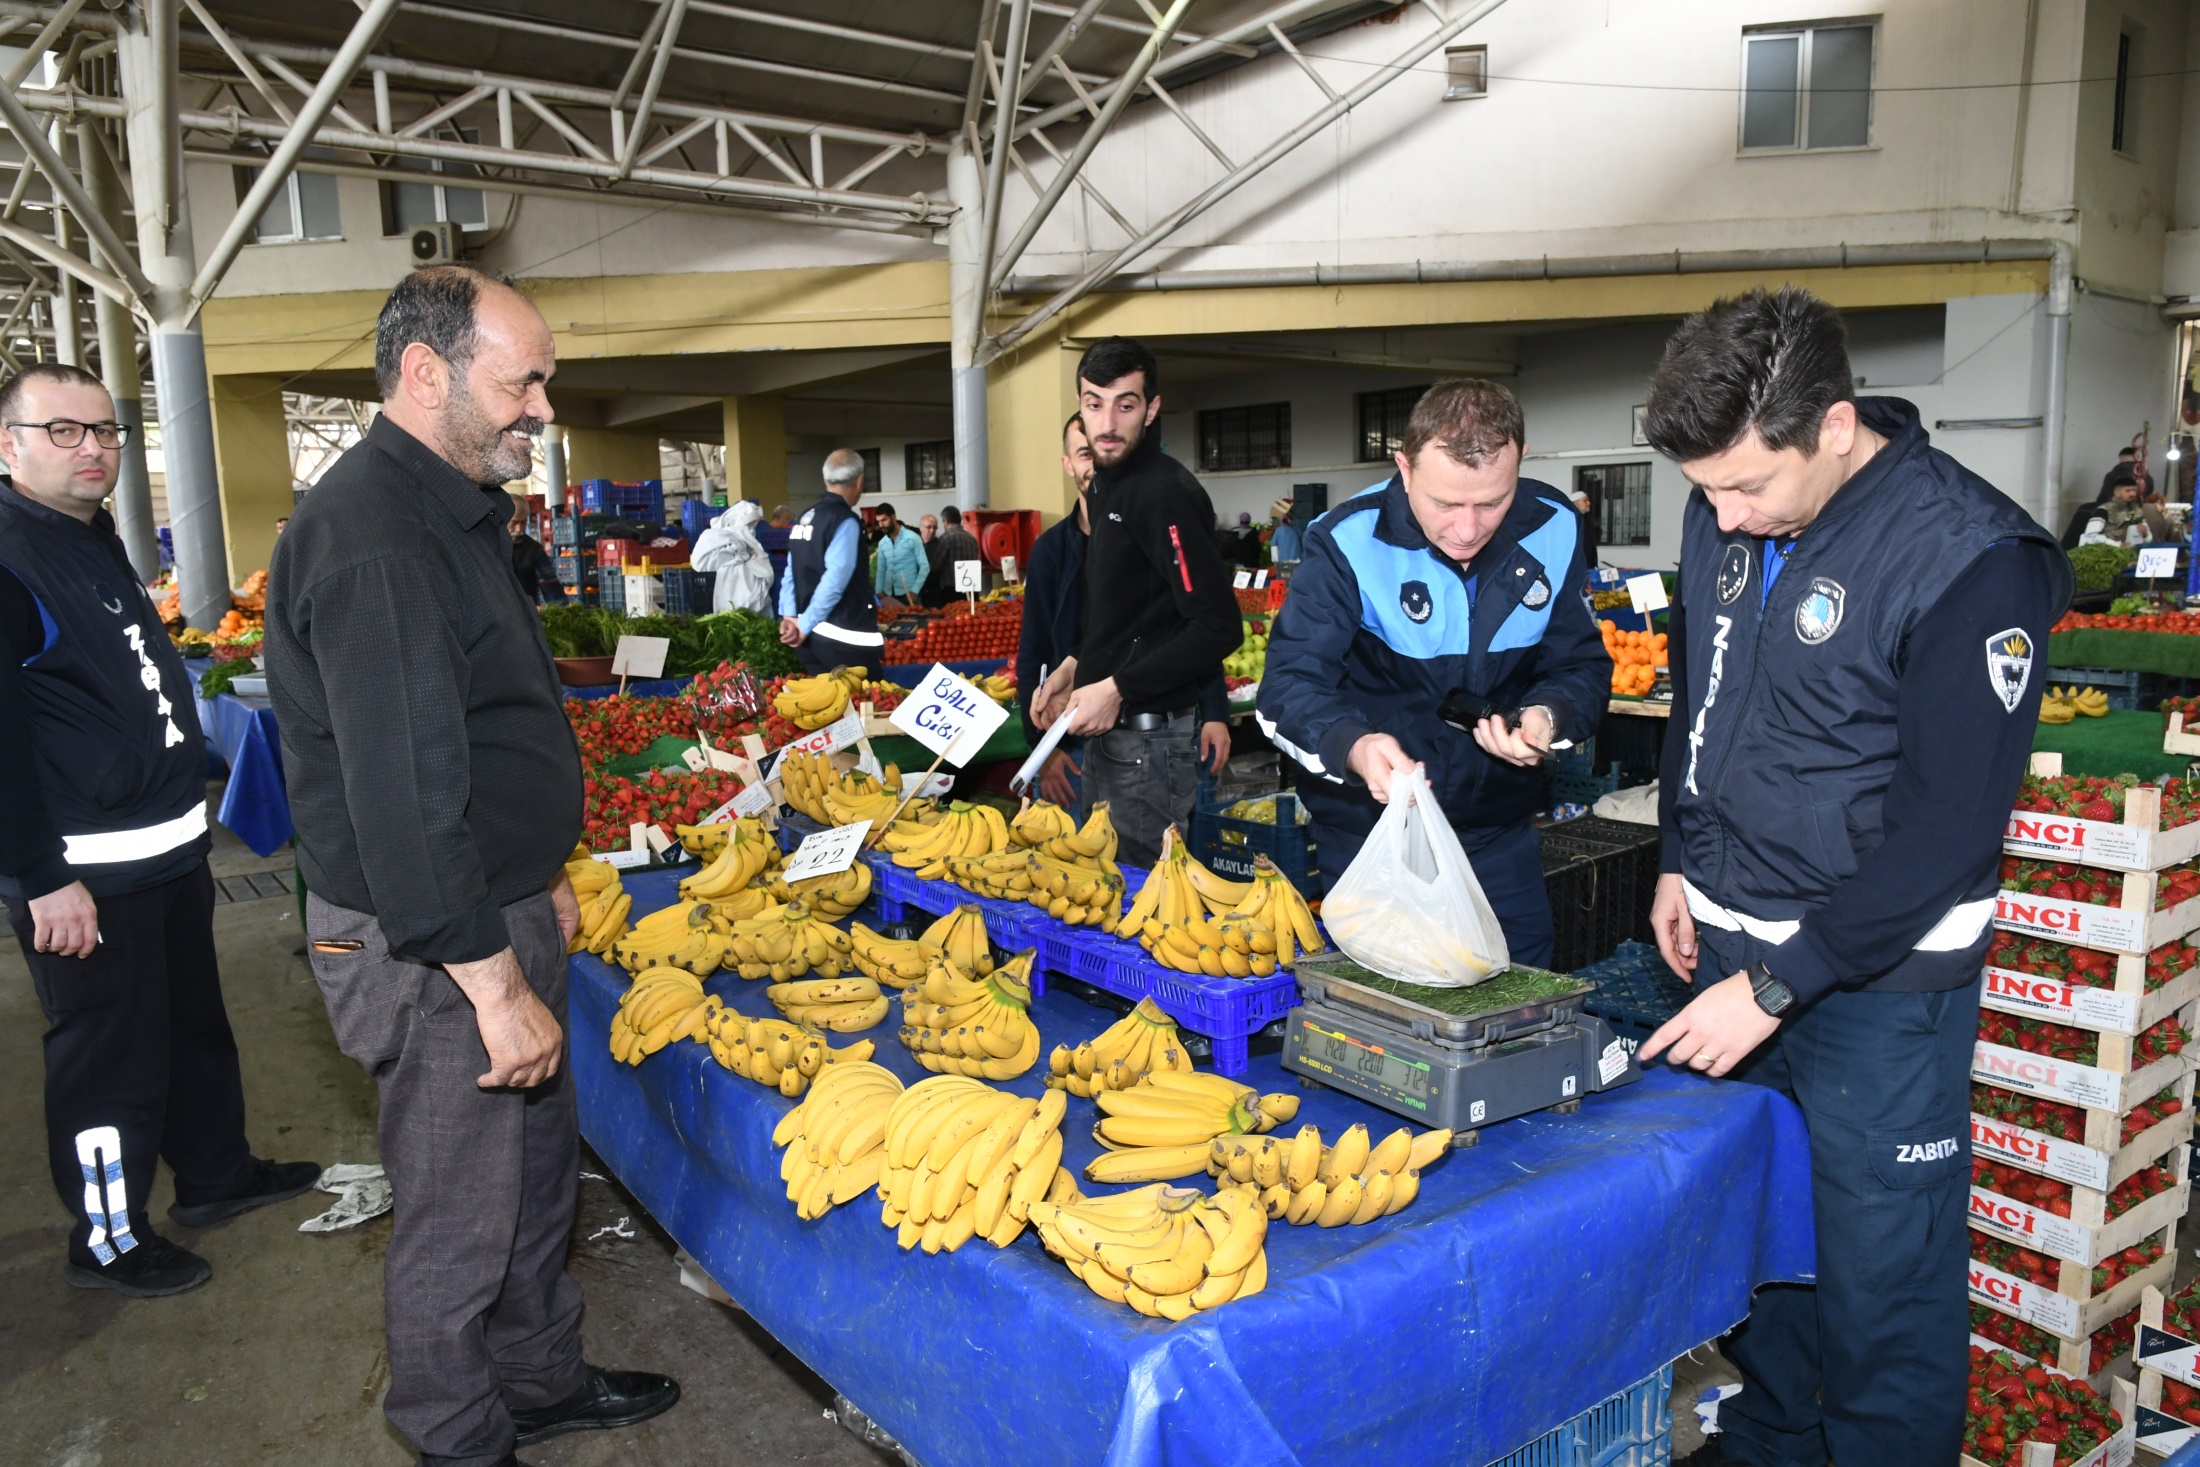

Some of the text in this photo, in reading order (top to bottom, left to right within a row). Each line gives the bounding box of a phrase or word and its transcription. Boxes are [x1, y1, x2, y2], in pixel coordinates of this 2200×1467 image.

[961, 568, 973, 587] 6
[933, 677, 977, 718] BALL
[808, 847, 845, 870] 22
[1994, 895, 2082, 932] İNCİ
[1986, 969, 2074, 1007] İNCİ
[1974, 1046, 2059, 1088] İNCİ
[1896, 1136, 1959, 1163] ZABITA
[1970, 1194, 2036, 1234] NCİ
[1968, 1270, 2023, 1306] NCİ
